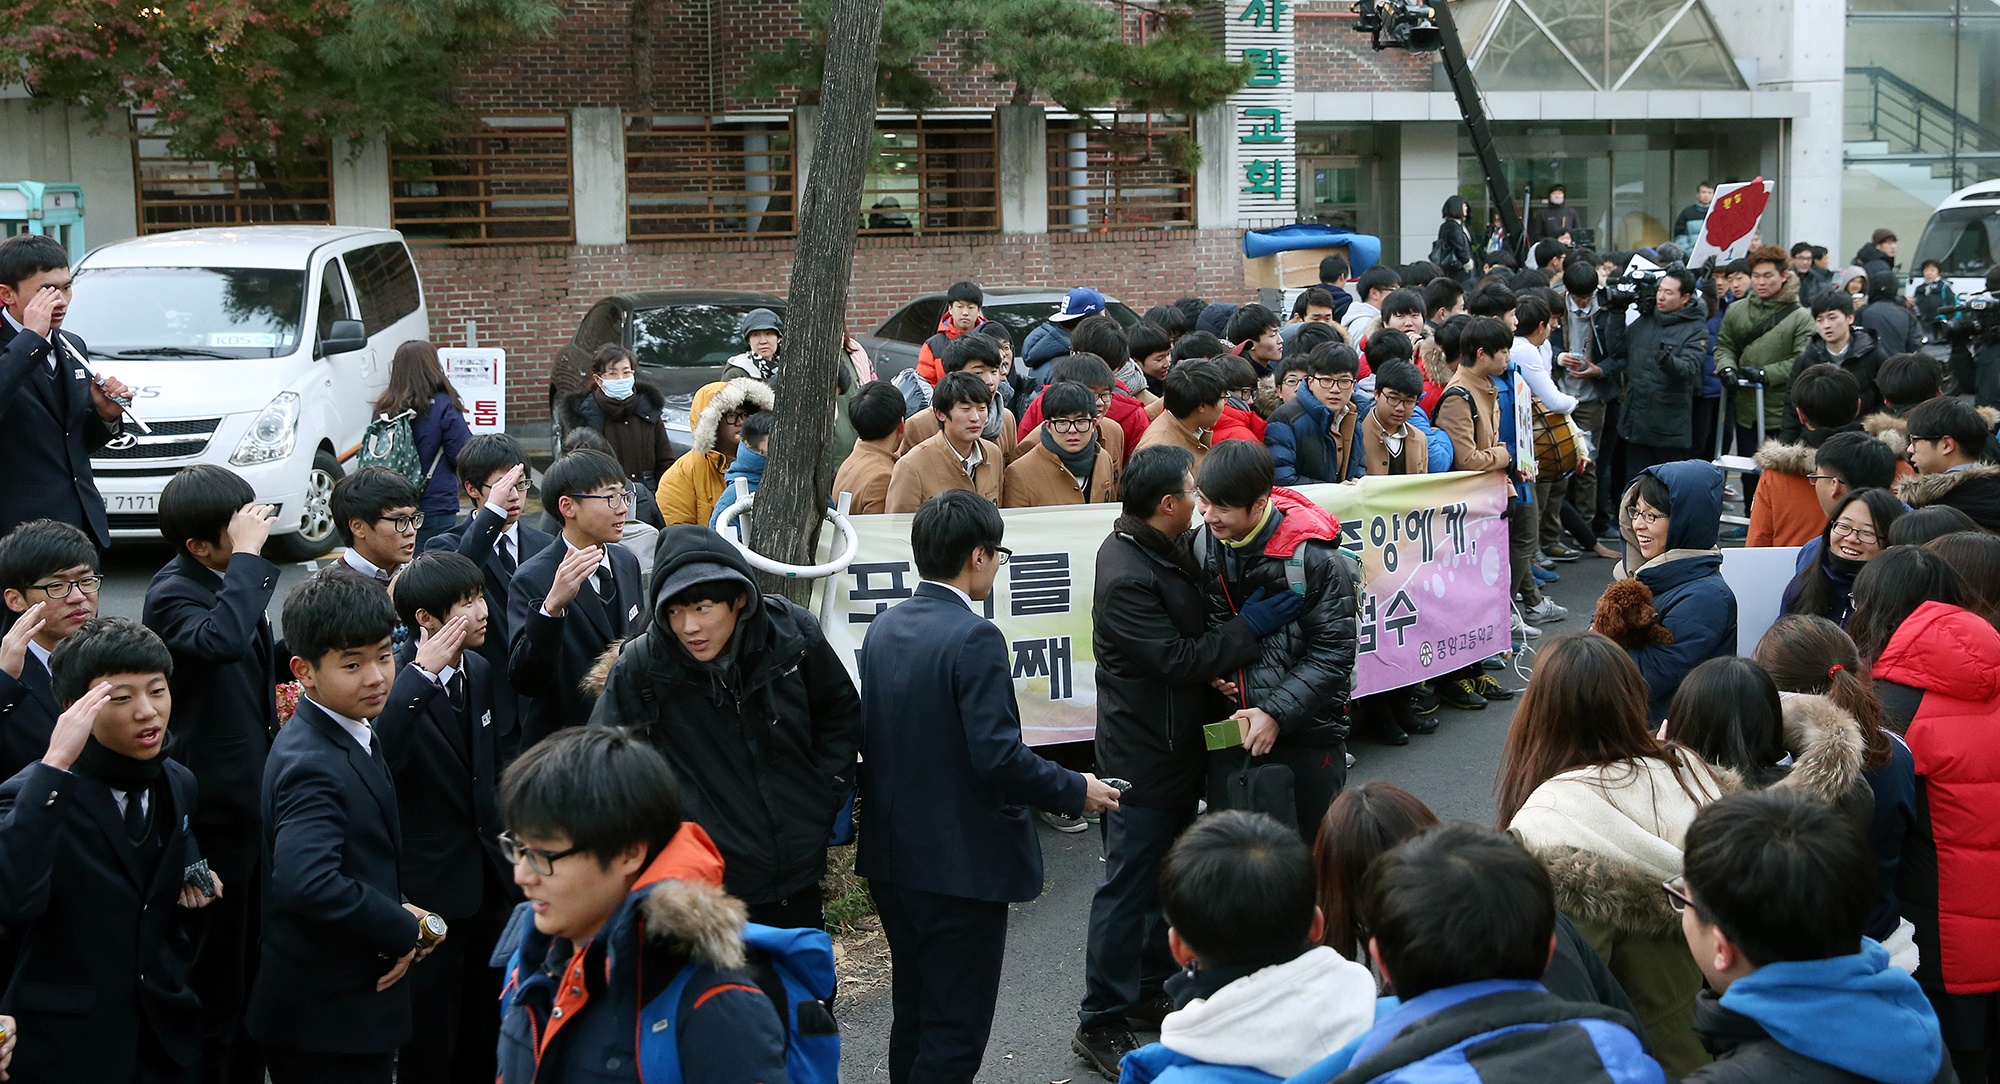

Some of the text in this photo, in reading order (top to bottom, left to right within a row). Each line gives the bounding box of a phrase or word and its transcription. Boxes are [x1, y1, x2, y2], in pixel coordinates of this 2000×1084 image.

[216, 336, 251, 345] KBS
[467, 400, 498, 426] 톱
[115, 496, 154, 510] 7171
[847, 552, 1072, 624] 포를
[1436, 624, 1494, 660] 중앙고등학교
